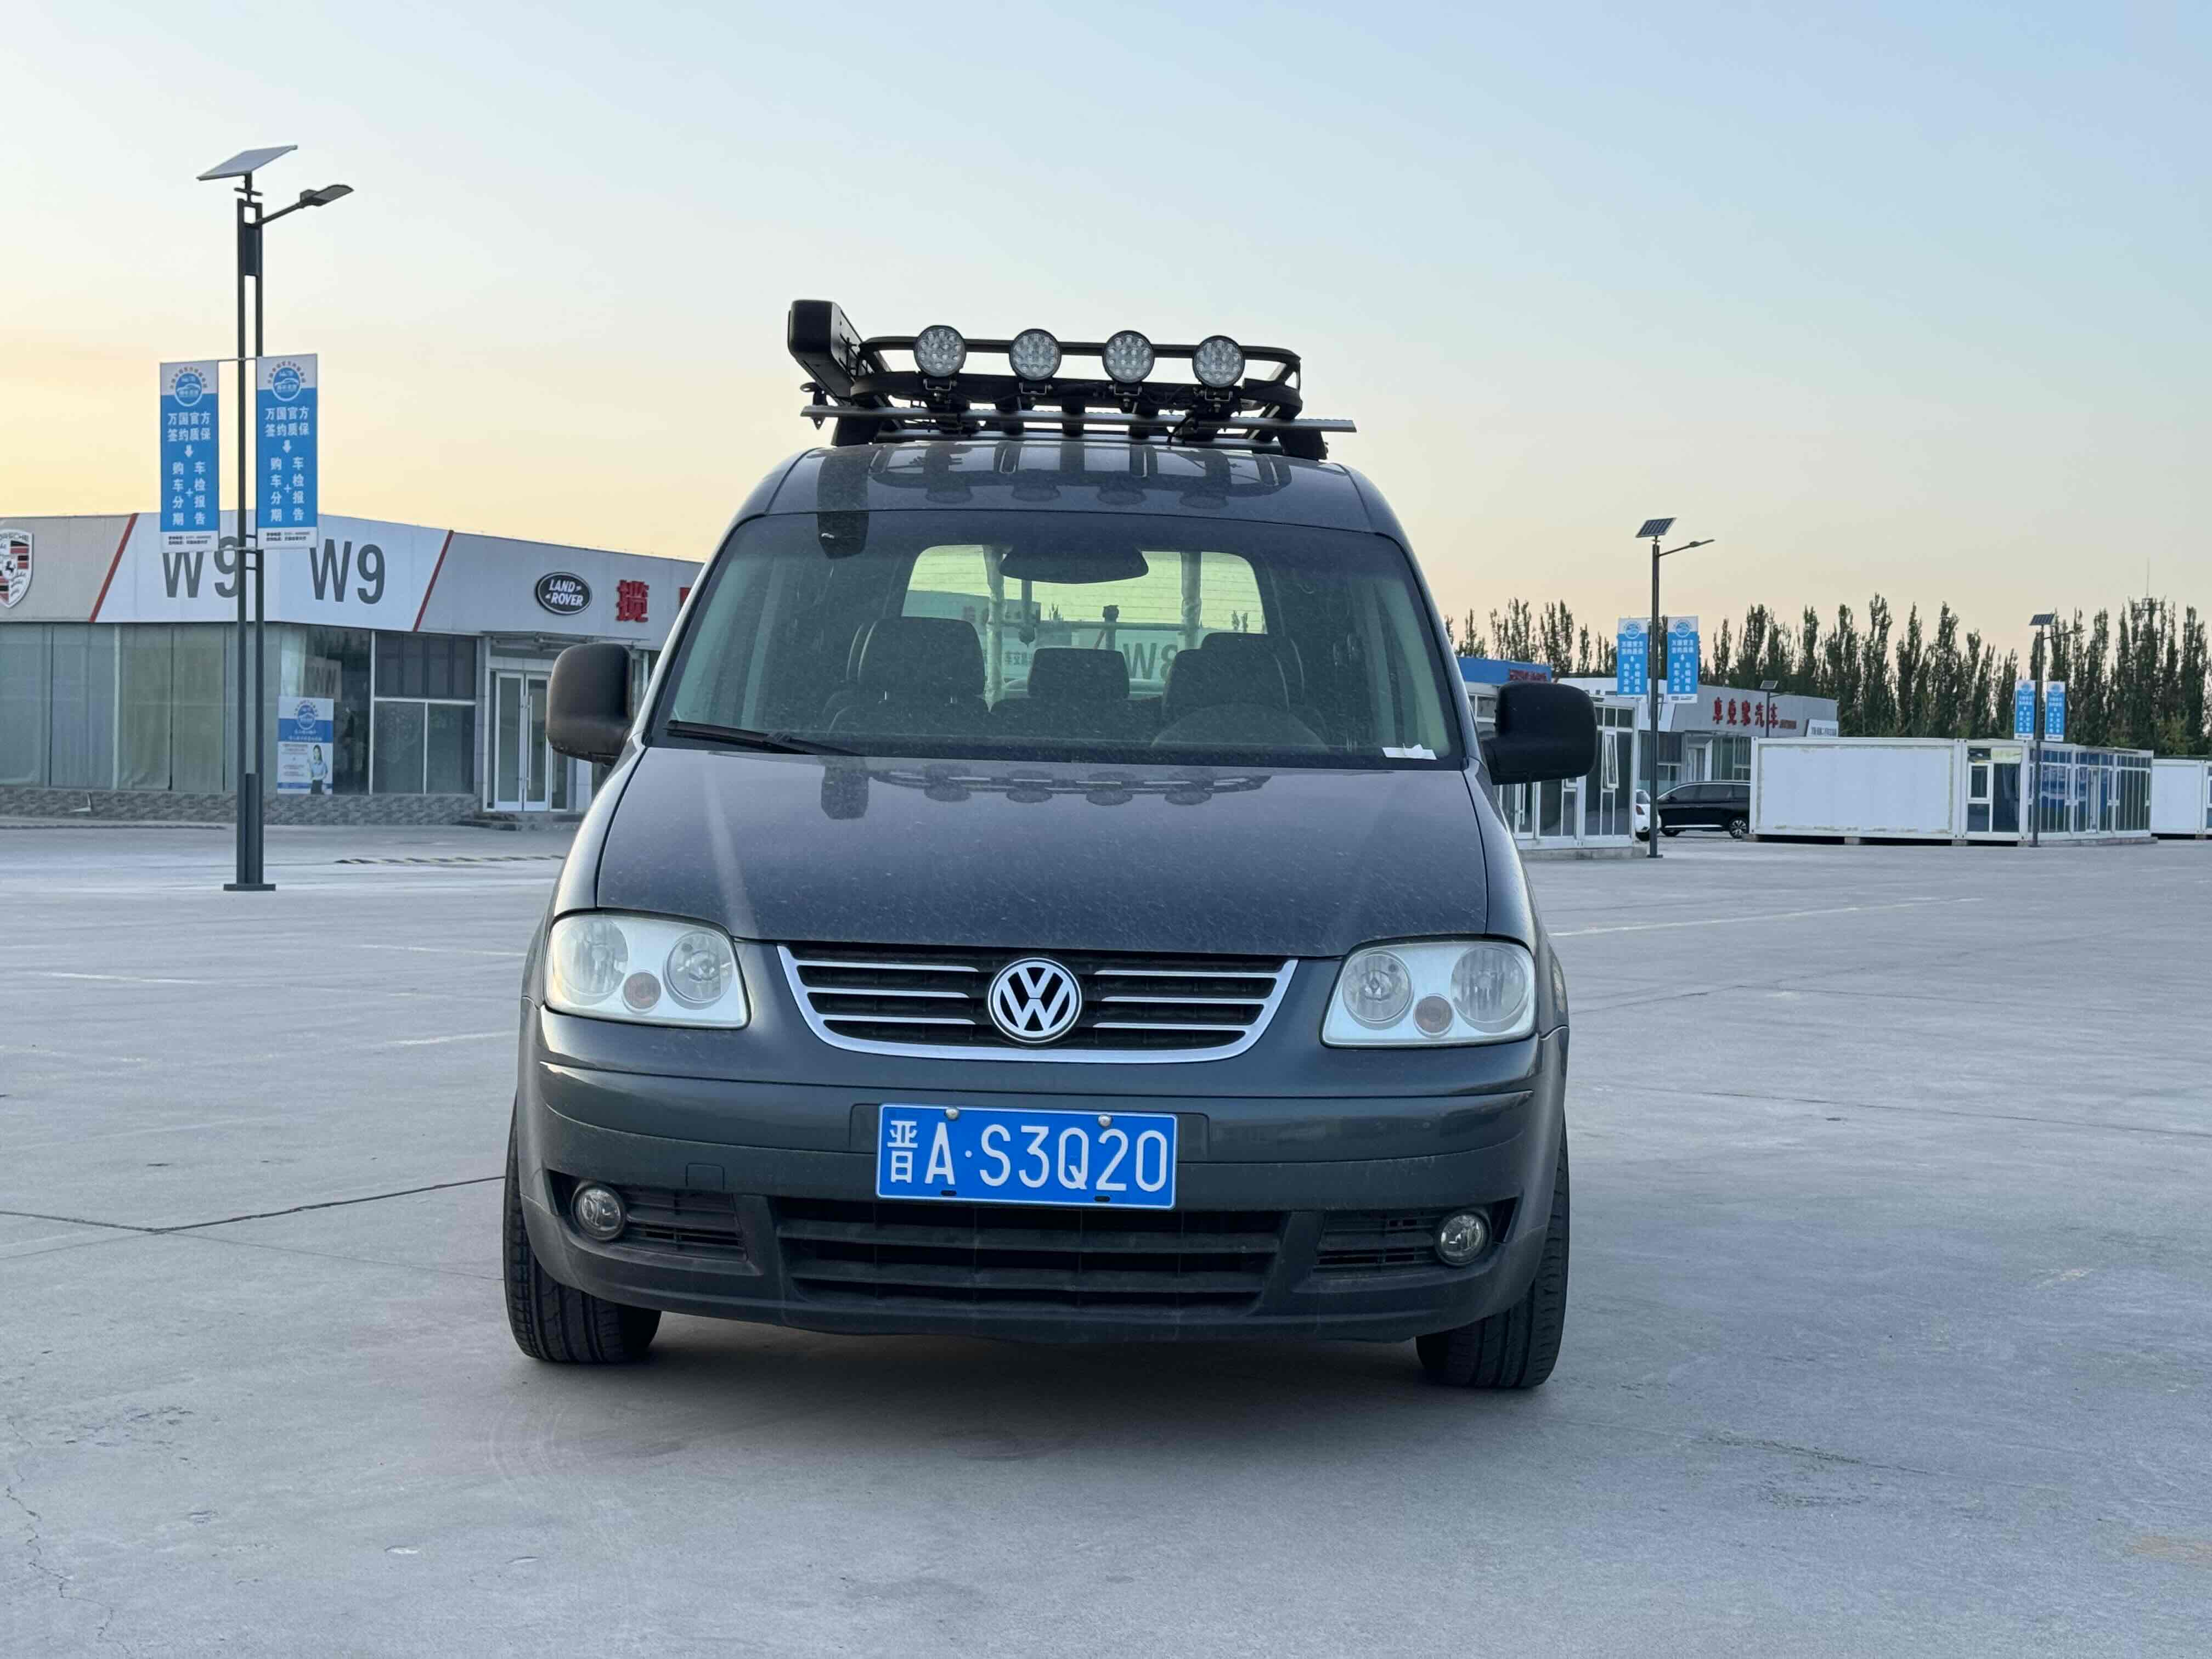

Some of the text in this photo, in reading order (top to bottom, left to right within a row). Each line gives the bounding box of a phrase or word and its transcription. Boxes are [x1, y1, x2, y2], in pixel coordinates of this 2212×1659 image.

[167, 411, 211, 426] 万国官方
[265, 406, 309, 421] 万国官方
[167, 428, 211, 442] 签约质保
[265, 422, 309, 438] 签约质保
[162, 536, 239, 598] W9
[309, 538, 385, 605] W9
[549, 579, 576, 593] LAND
[551, 592, 584, 606] ROVER
